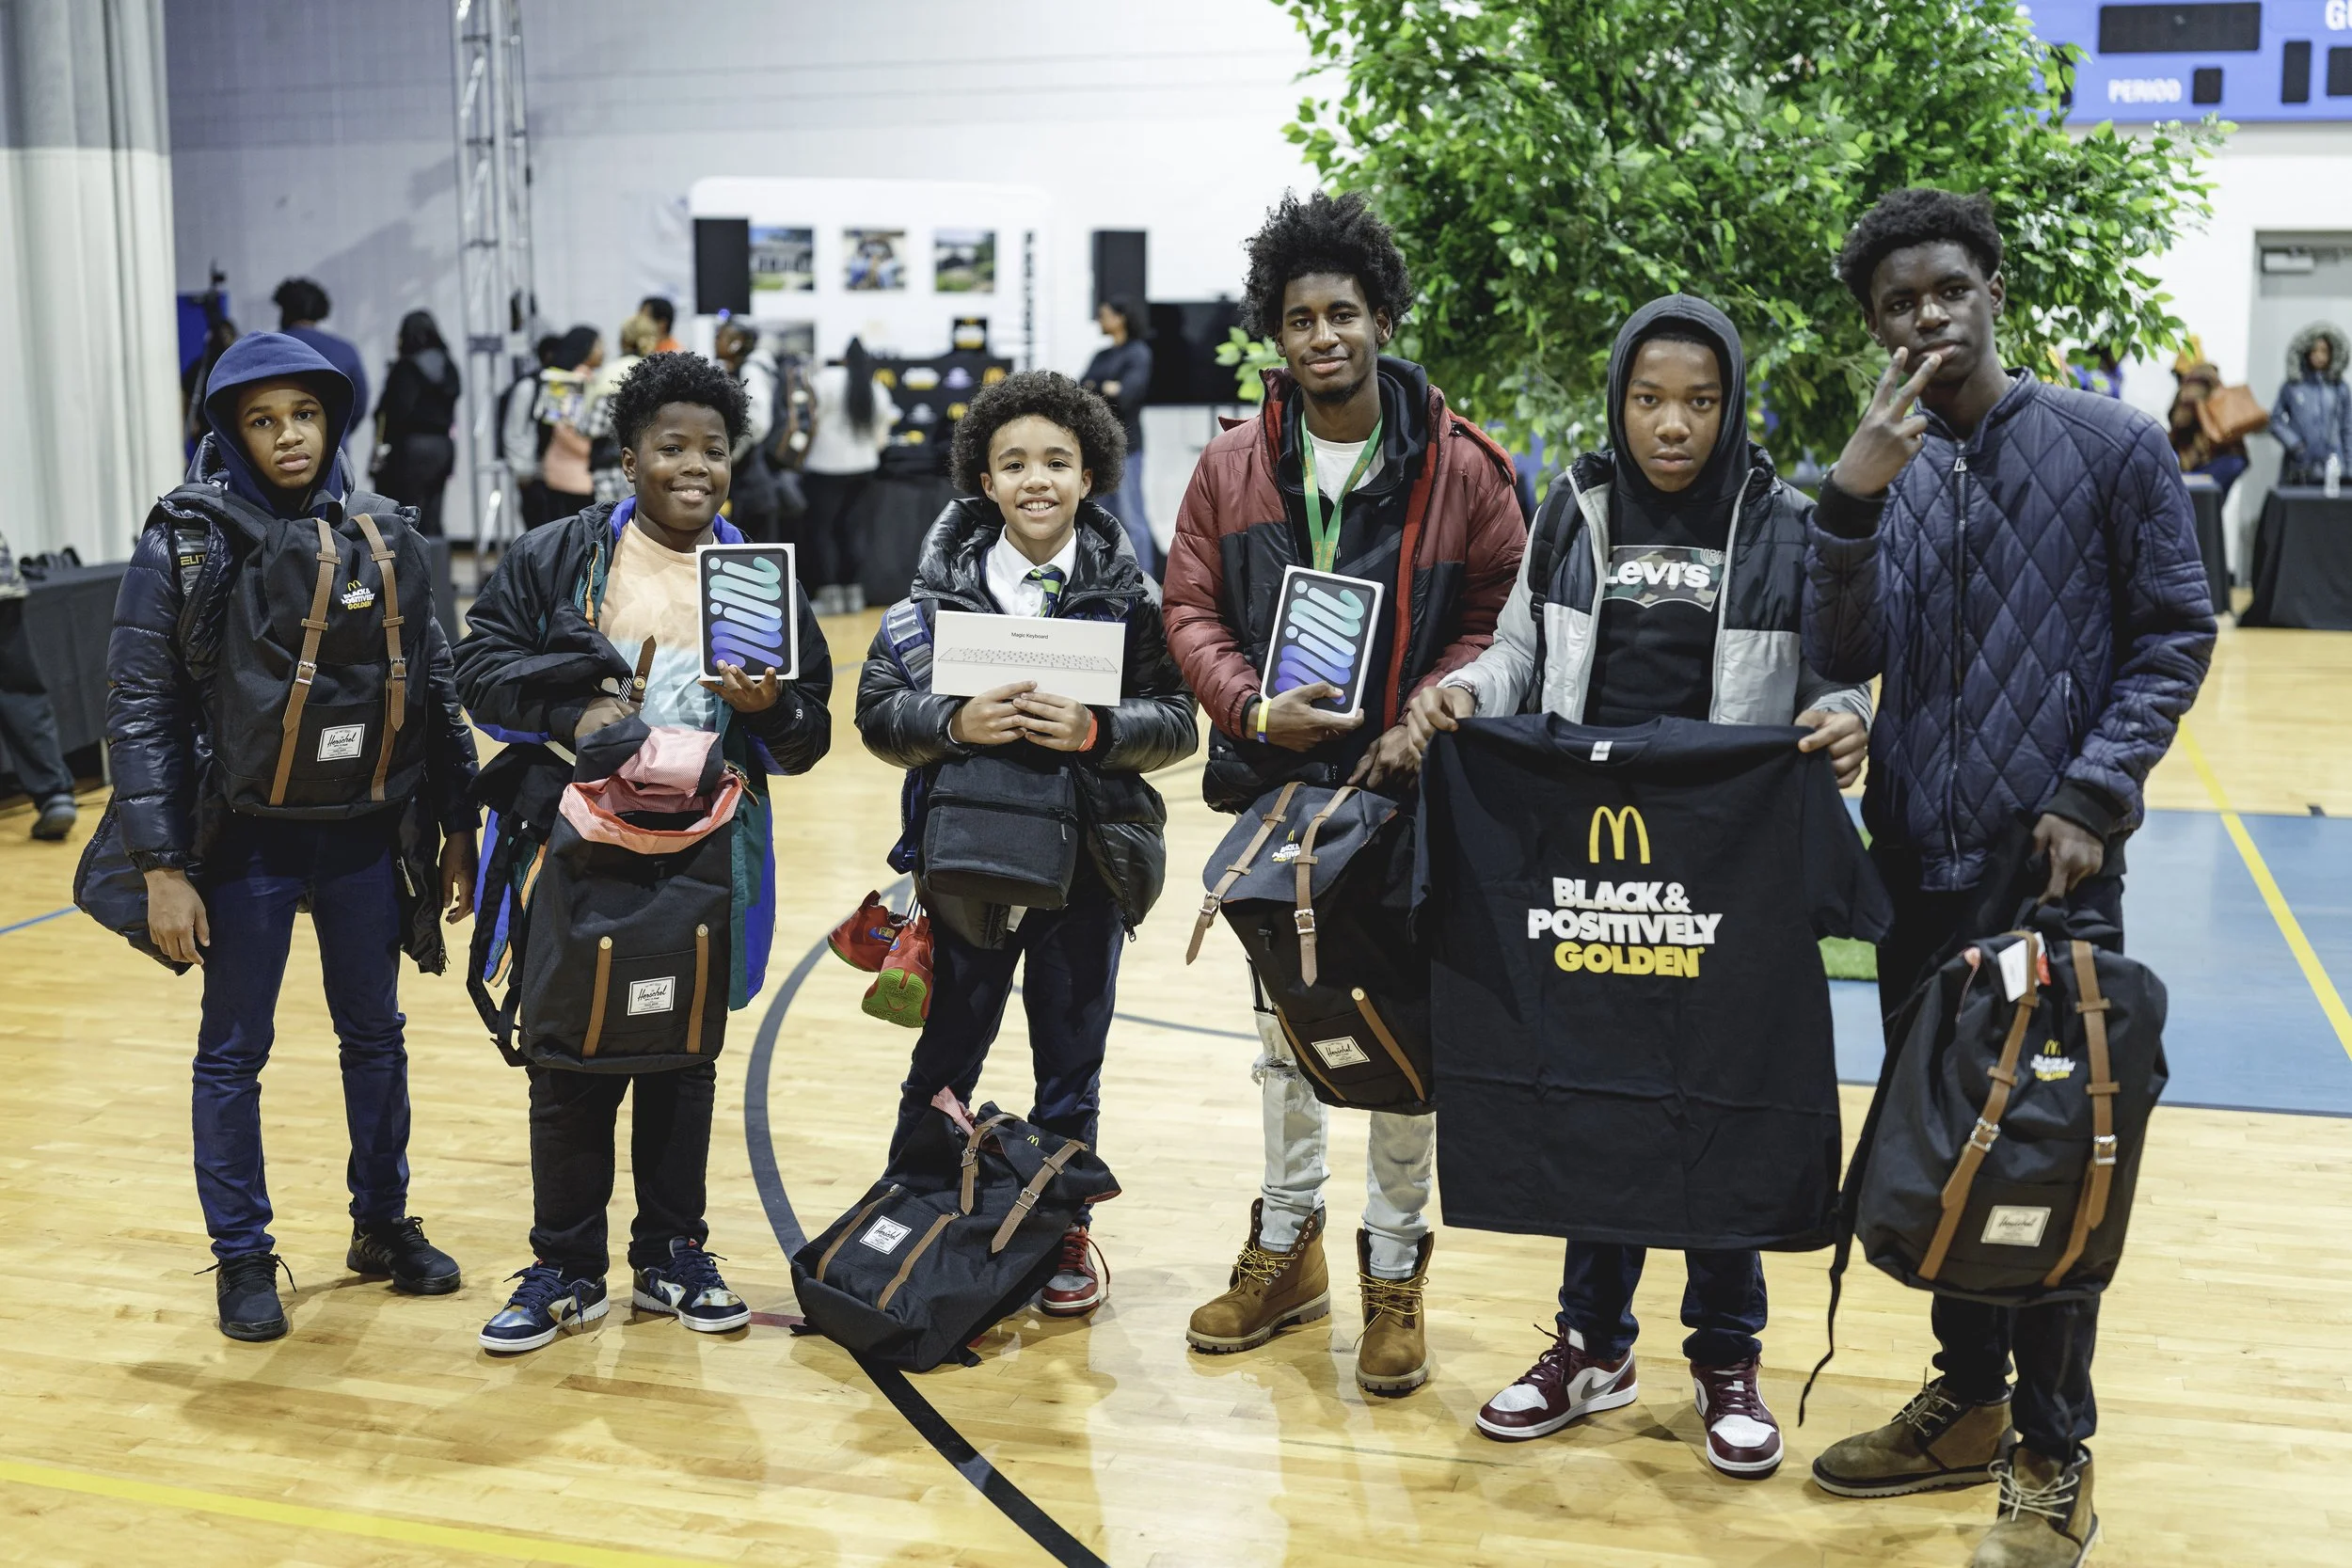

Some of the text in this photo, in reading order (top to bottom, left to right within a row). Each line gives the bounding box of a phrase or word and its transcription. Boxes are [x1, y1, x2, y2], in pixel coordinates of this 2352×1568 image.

[2107, 78, 2182, 103] PERIOD
[341, 593, 375, 604] POSITIVELY
[348, 601, 372, 610] GOLDEN
[326, 732, 357, 748] Herschel
[1528, 909, 1724, 945] POSITIVELY
[1554, 941, 1700, 978] GOLDEN
[637, 984, 667, 1002] Herschel
[1325, 1043, 1352, 1057] Herschel
